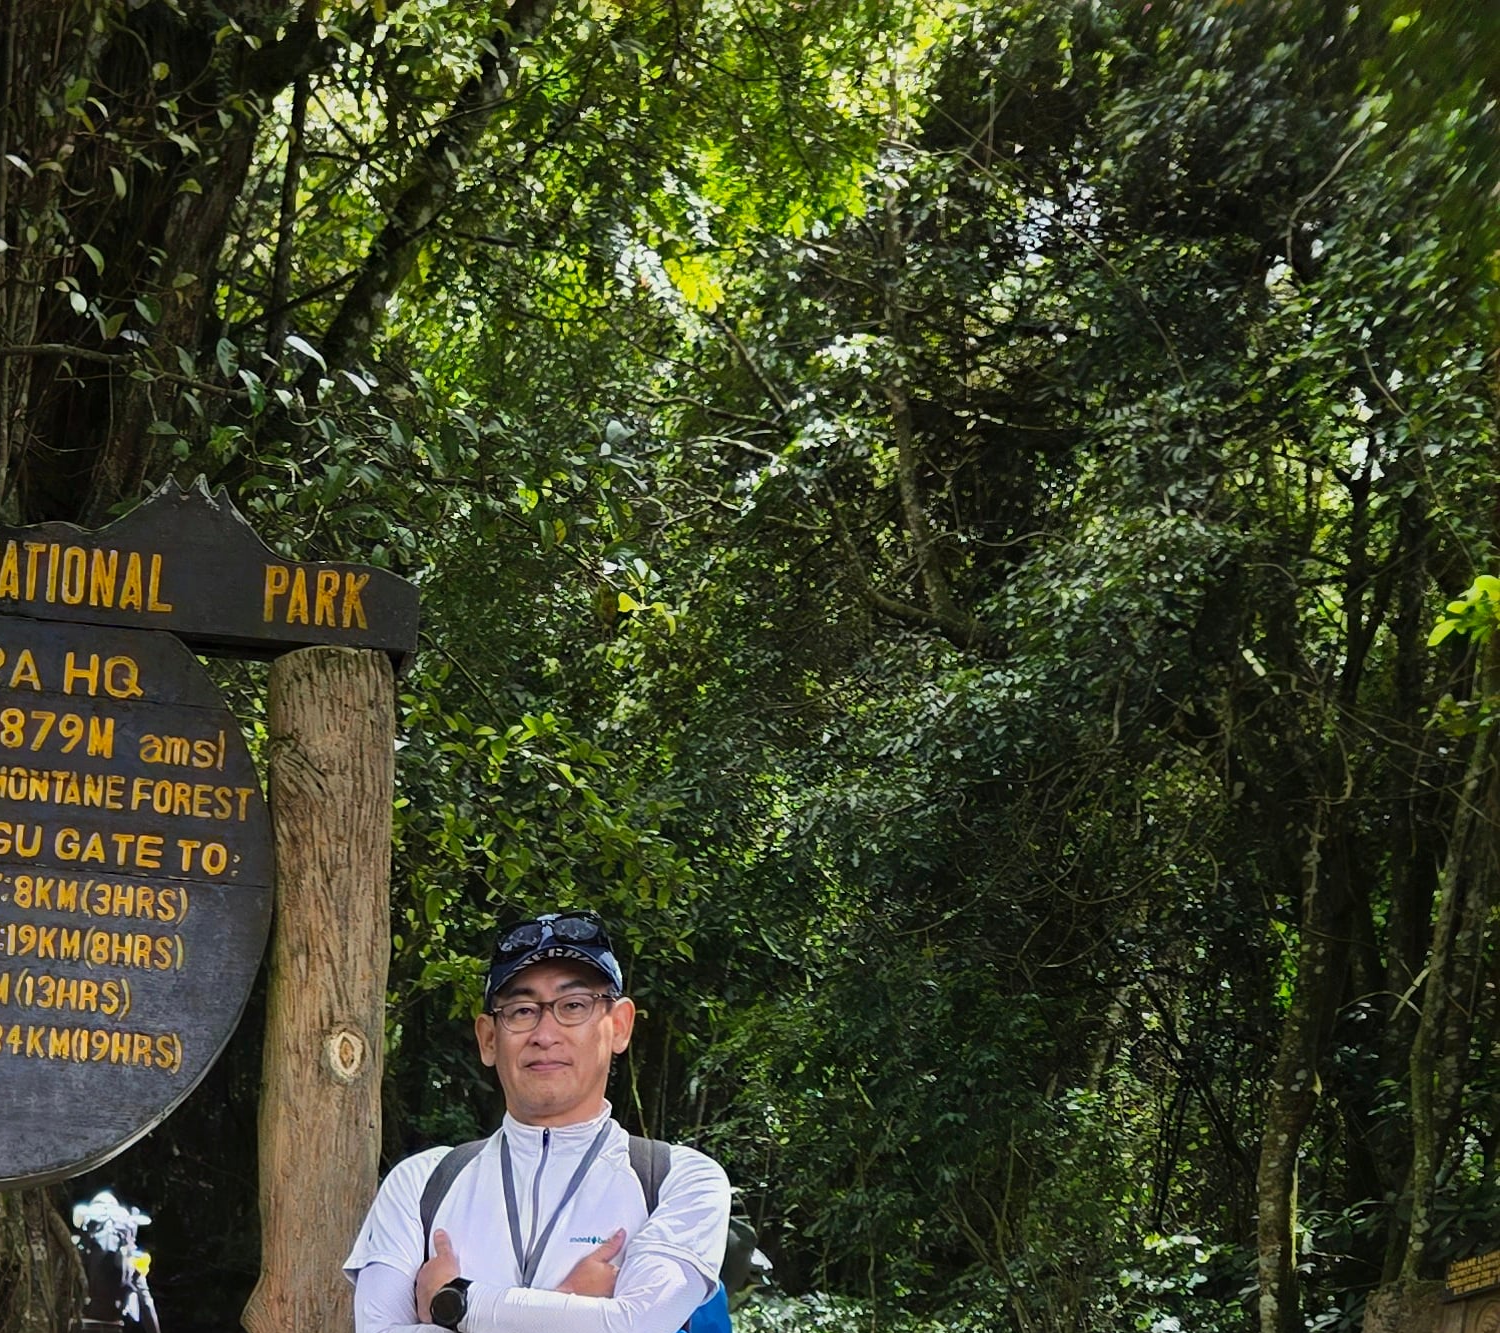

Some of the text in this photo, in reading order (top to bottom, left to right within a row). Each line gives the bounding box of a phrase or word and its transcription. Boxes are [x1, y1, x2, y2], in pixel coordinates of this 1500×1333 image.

[263, 564, 370, 629] PARK
[63, 651, 145, 698] HQ
[139, 730, 226, 772] amsl
[131, 777, 255, 822] FOREST
[54, 827, 164, 869] GATE
